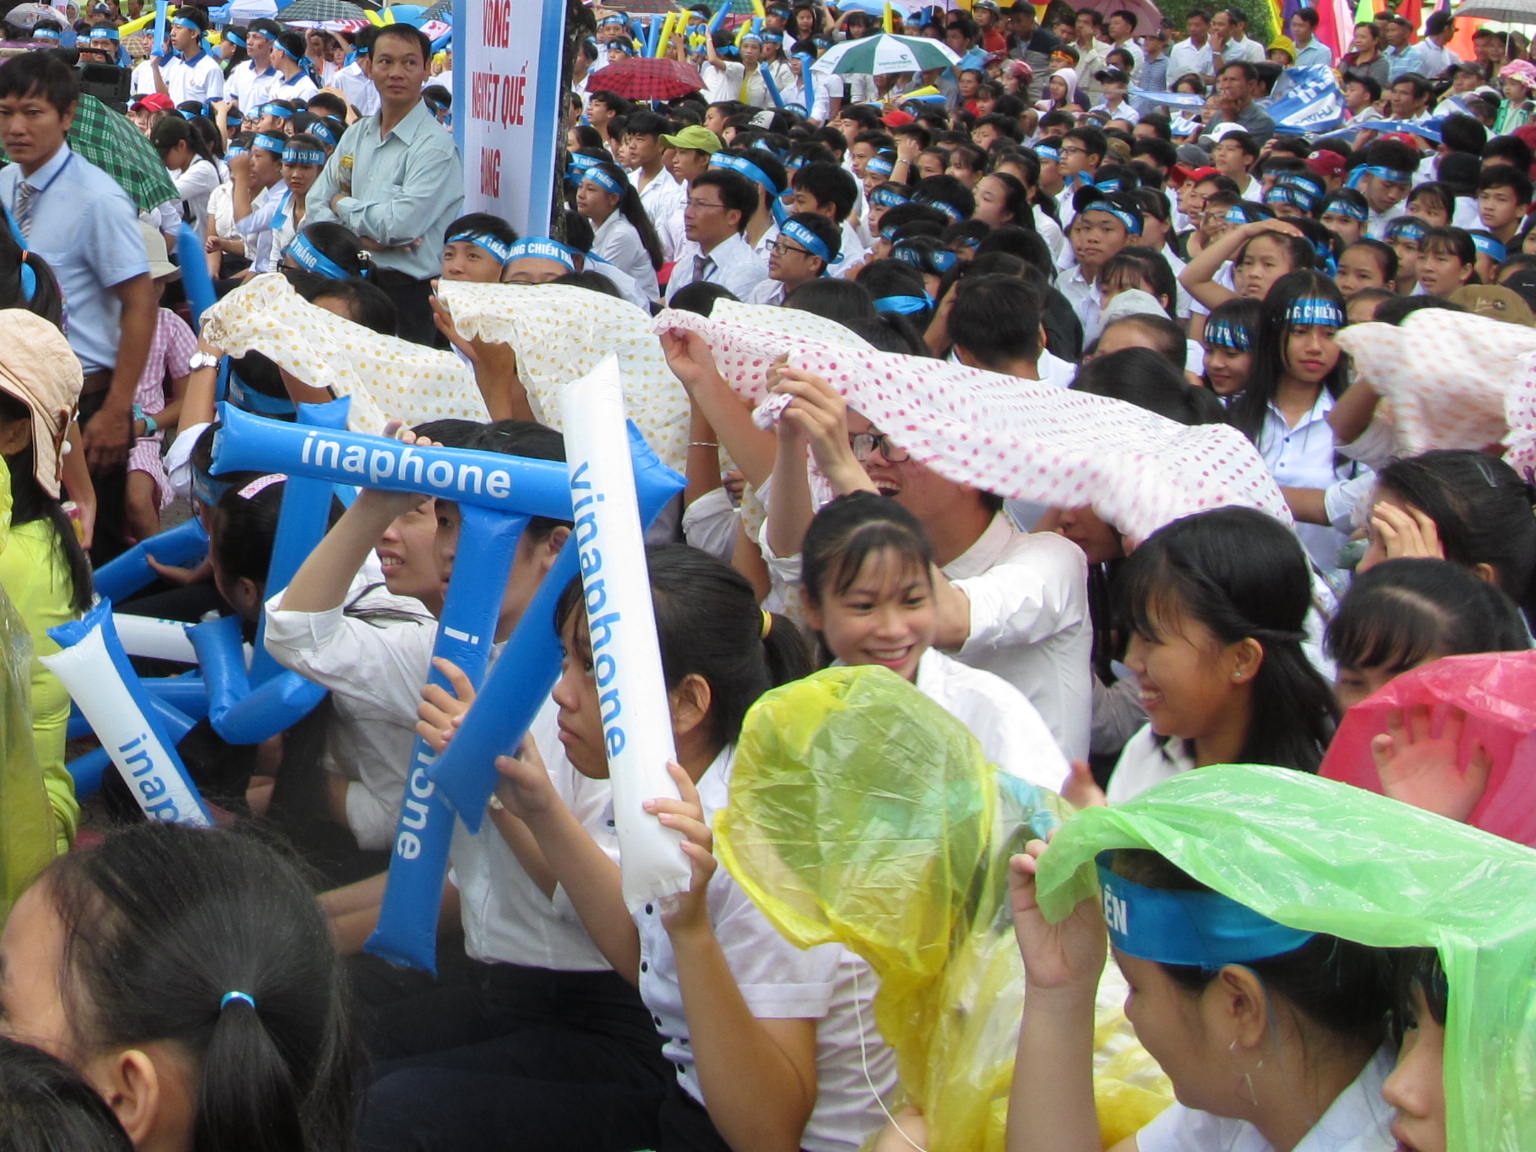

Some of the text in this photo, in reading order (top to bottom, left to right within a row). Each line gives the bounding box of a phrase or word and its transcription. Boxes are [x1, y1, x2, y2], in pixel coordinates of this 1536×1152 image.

[527, 242, 560, 259] CHIẾN
[300, 430, 512, 499] inaphone
[570, 461, 626, 760] vinaphone
[1104, 883, 1129, 936] ÊN
